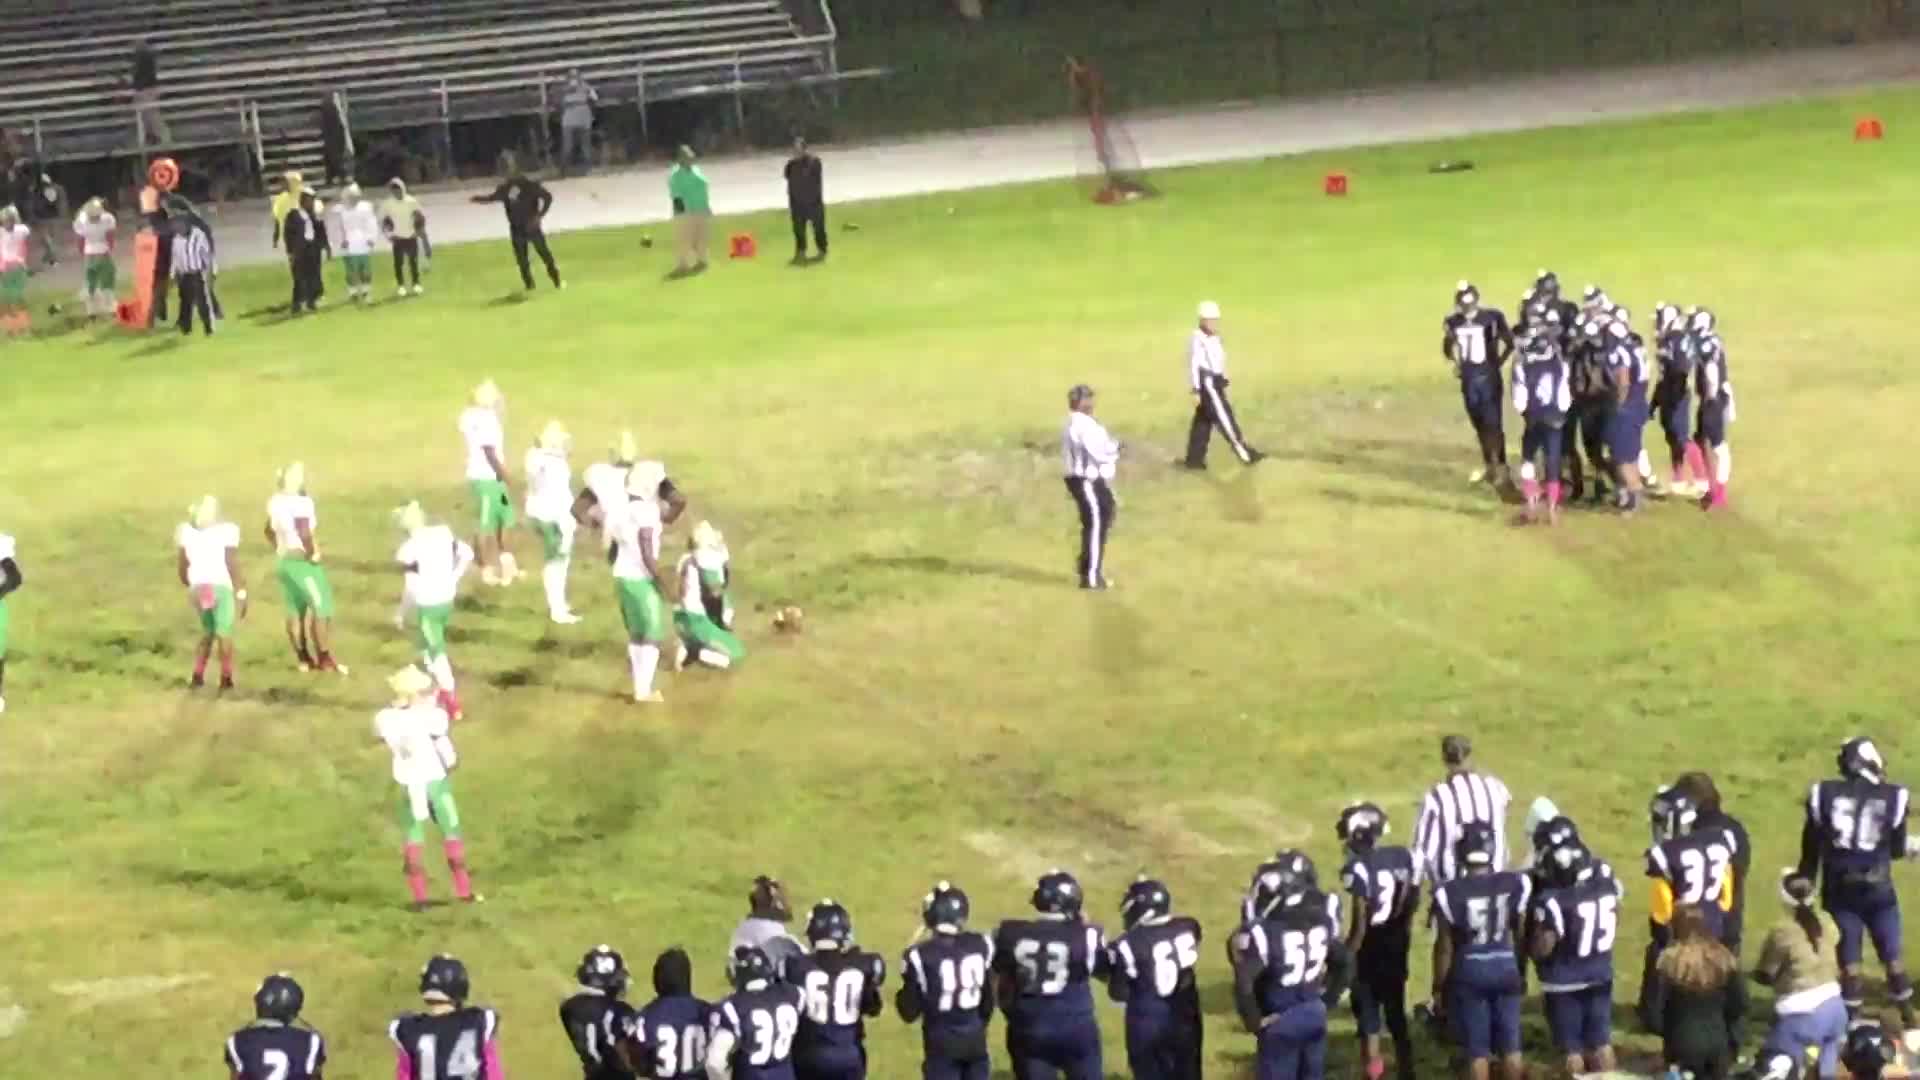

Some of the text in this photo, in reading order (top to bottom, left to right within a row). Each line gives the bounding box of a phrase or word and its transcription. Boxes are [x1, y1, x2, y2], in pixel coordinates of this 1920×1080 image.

[1680, 843, 1730, 904] 33
[1577, 894, 1617, 958] 75
[1014, 938, 1070, 995] 53
[1281, 926, 1329, 987] 55
[805, 968, 865, 1026] 60
[416, 1028, 481, 1080] 14
[655, 1024, 706, 1078] 30
[750, 1004, 798, 1066] 38
